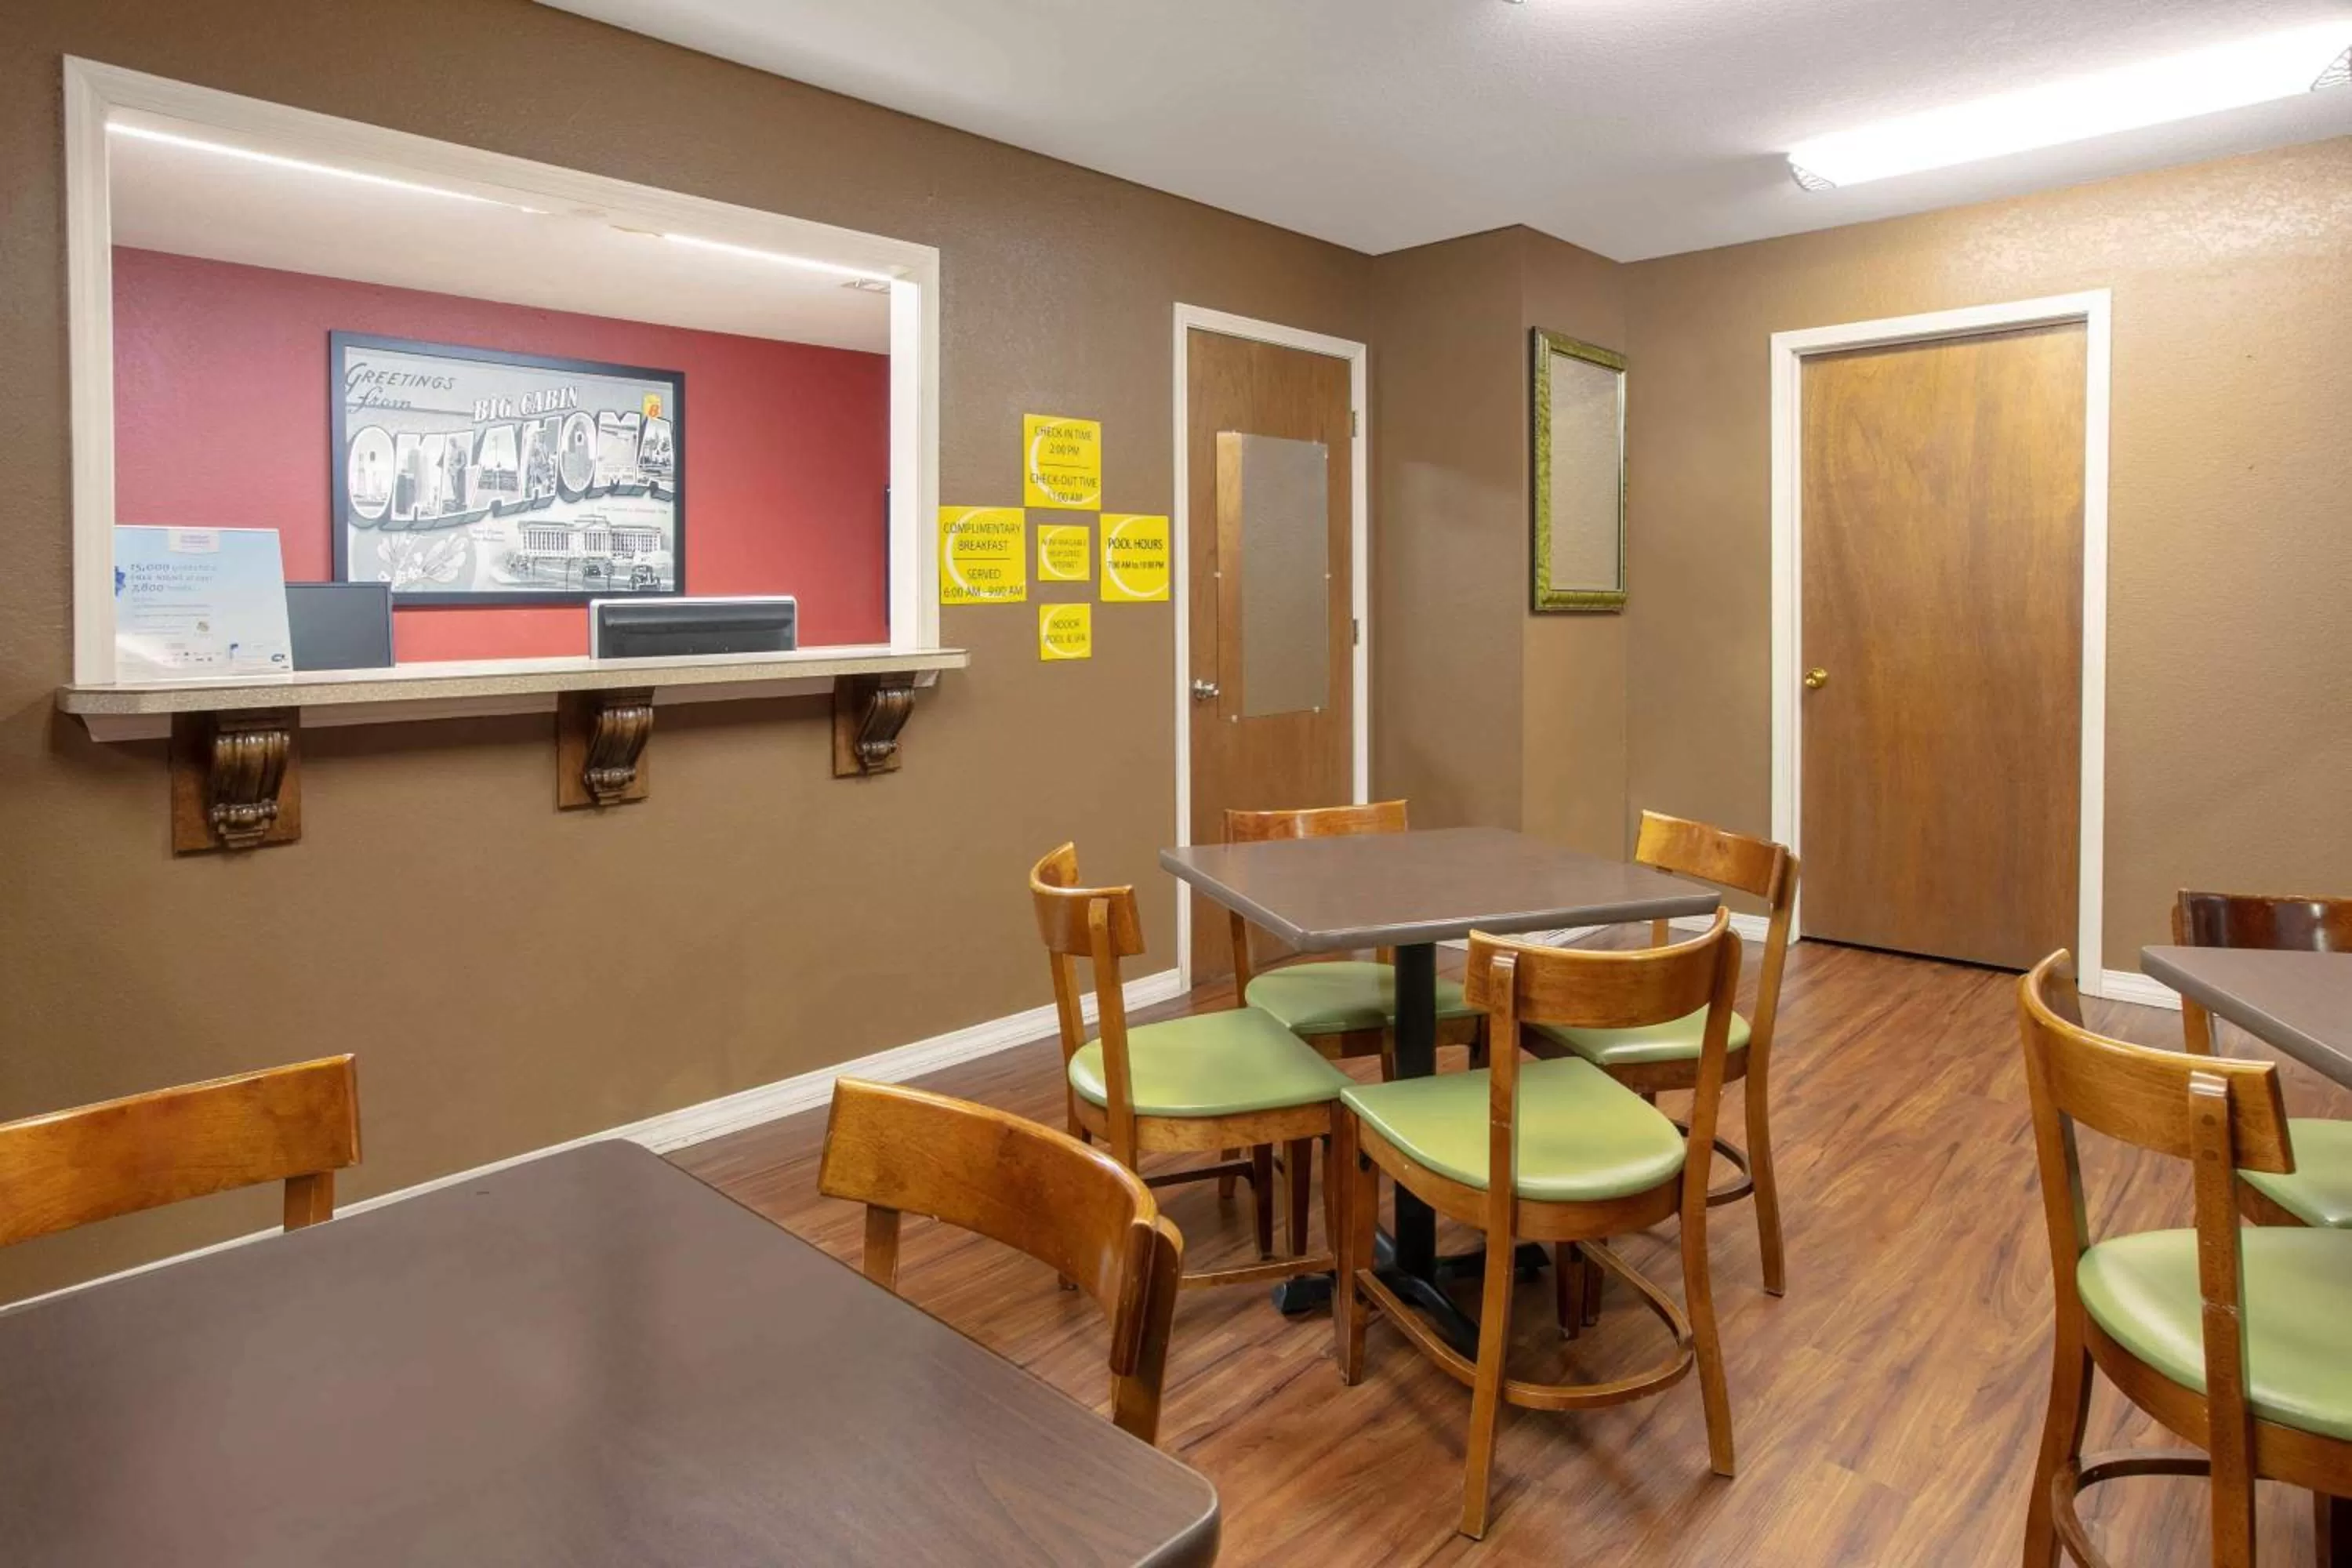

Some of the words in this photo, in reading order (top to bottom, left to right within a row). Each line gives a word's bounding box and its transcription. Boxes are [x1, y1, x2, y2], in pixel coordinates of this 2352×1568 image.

[346, 362, 457, 392] GREETINGS
[347, 386, 411, 414] from
[474, 397, 511, 423] BIG
[520, 386, 579, 416] CABIN
[1068, 445, 1080, 456] PM
[348, 410, 674, 527] OKLAHOMA
[1079, 476, 1098, 488] TIME
[1070, 492, 1083, 502] AM
[943, 522, 1021, 534] COMPLIMENTARY
[959, 539, 1010, 551] BREAKFAST
[1108, 537, 1133, 550] POOL
[1134, 539, 1163, 550] HOURS
[967, 568, 1001, 579] SERVED
[943, 586, 964, 597] 6:00
[966, 586, 981, 597] AM
[1009, 585, 1023, 596] AM
